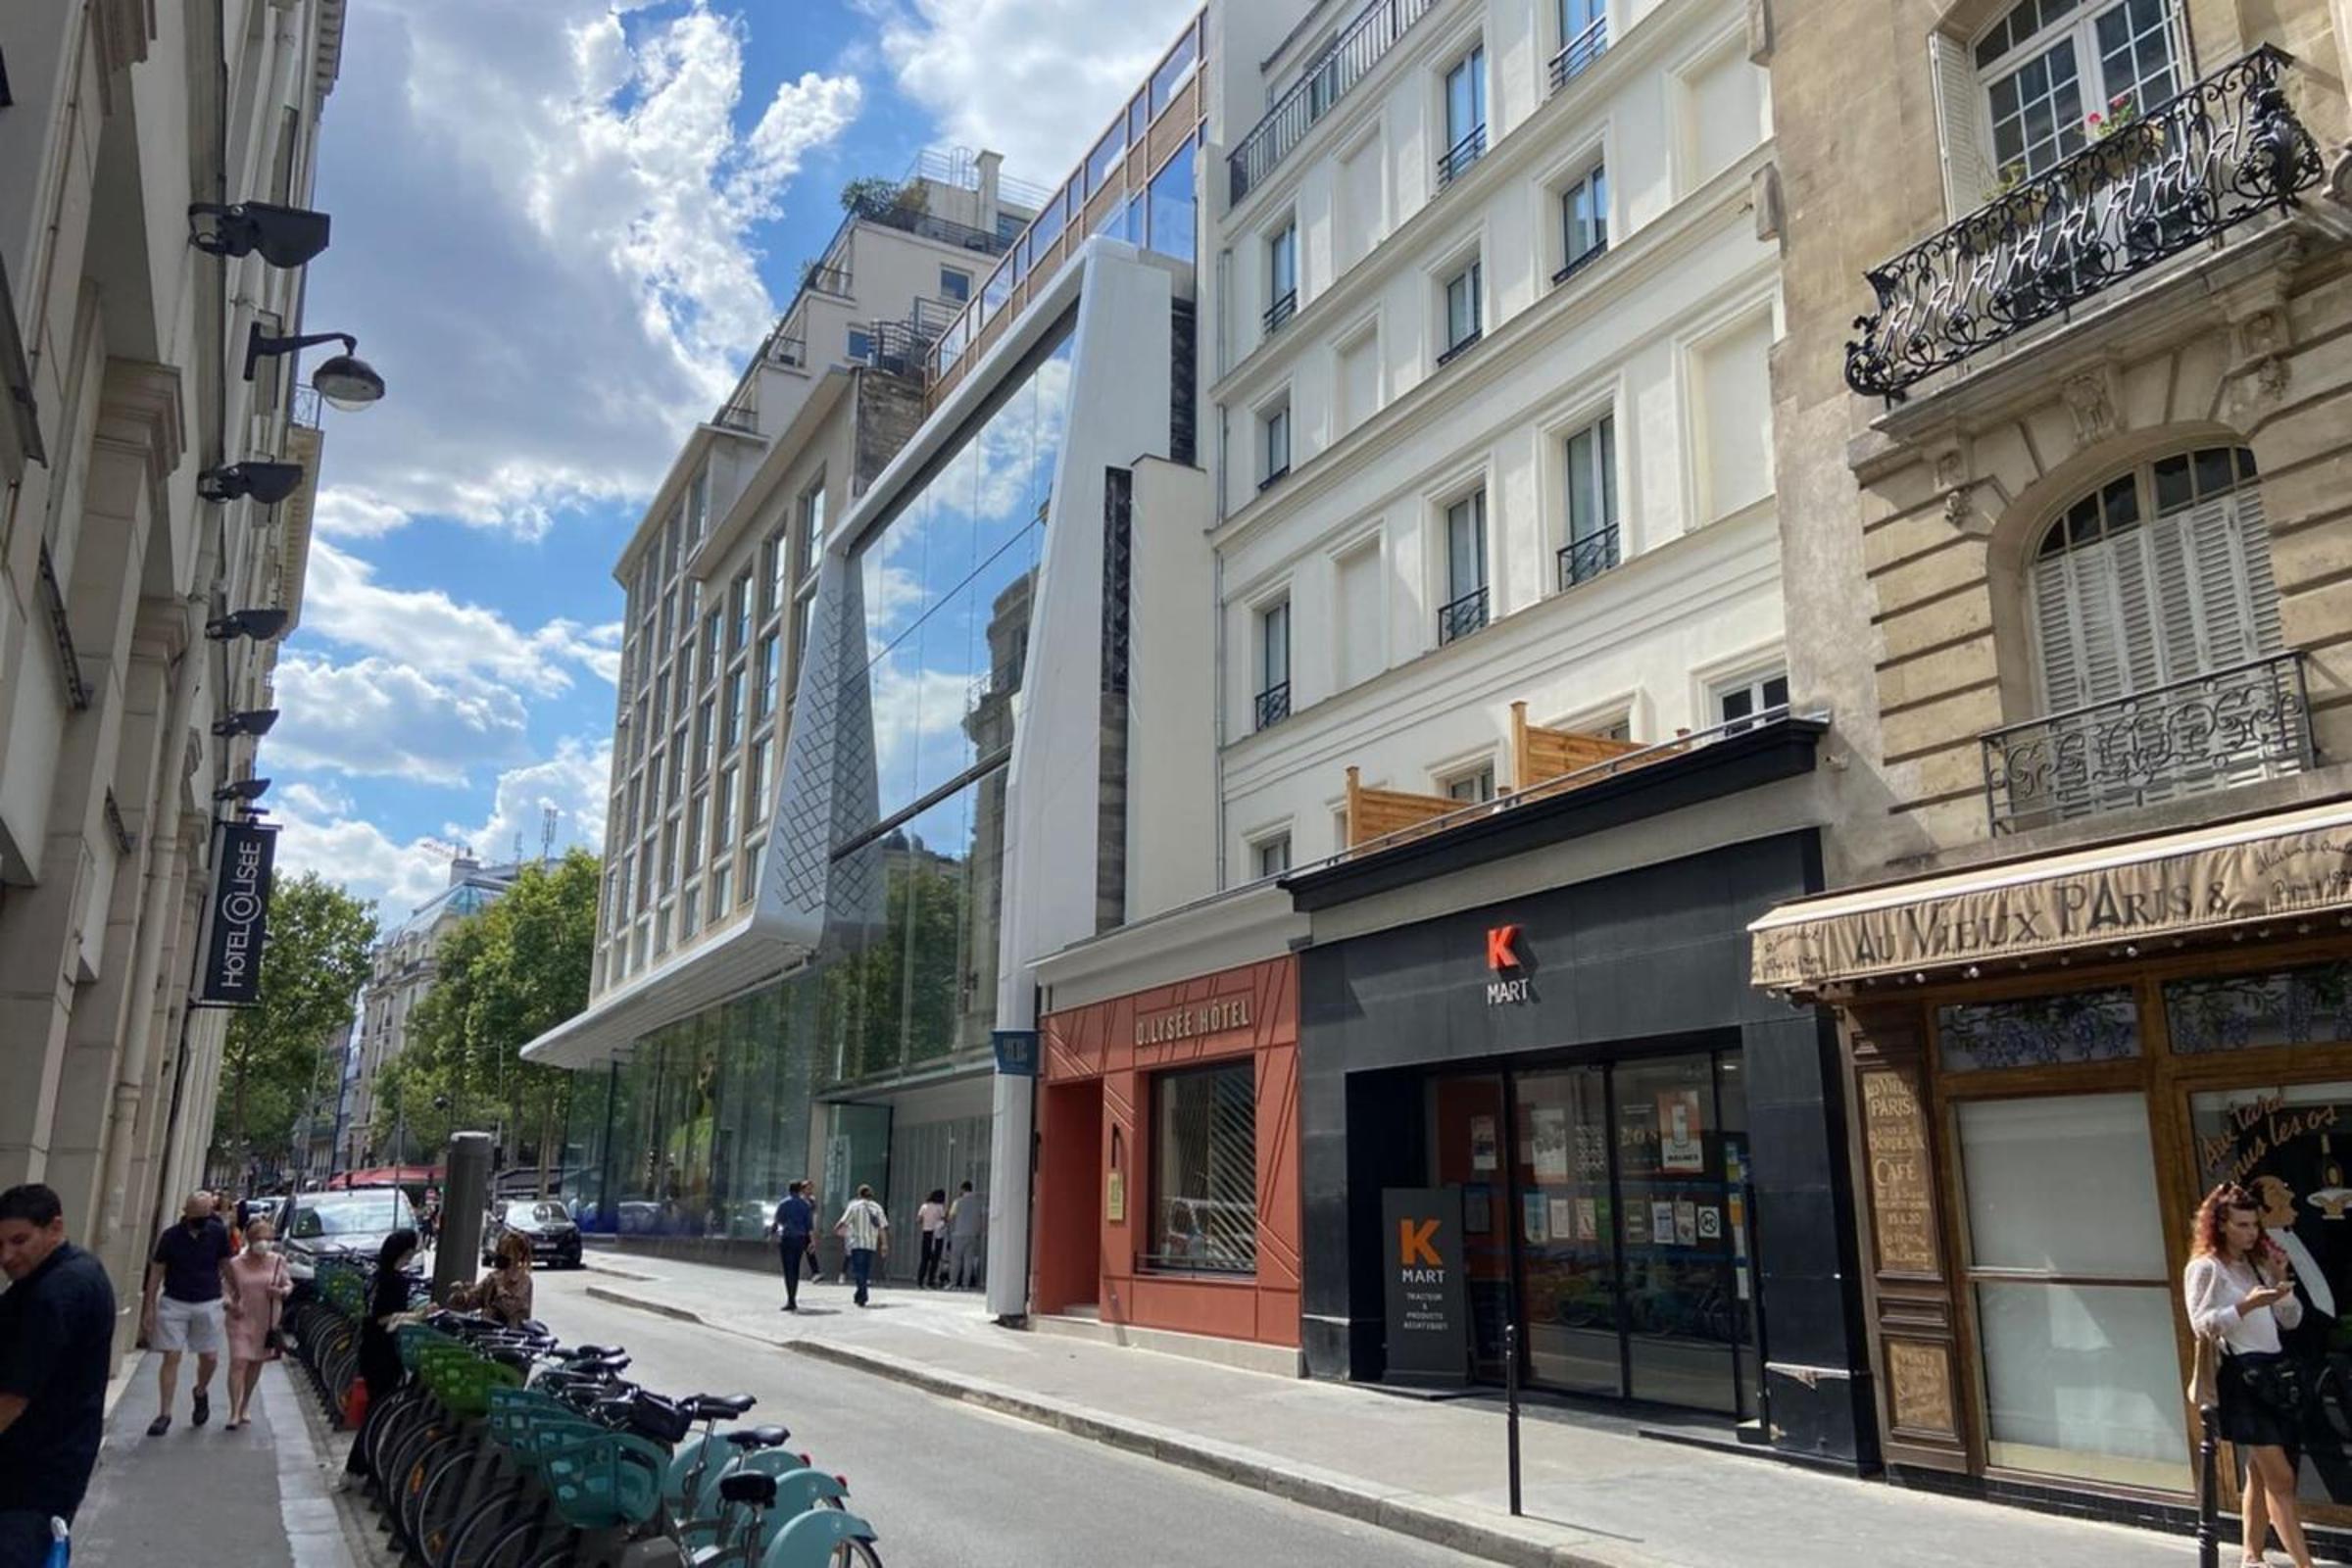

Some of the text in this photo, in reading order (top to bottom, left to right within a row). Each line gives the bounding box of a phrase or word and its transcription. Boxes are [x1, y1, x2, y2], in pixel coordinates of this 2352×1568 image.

[1856, 913, 1896, 962] AU
[1905, 902, 2042, 957] VIEUX
[2053, 876, 2192, 937] PARIS
[1487, 924, 1523, 970] K
[1487, 978, 1529, 1005] MART
[1199, 998, 1250, 1033] HÔTEL
[1874, 1158, 1918, 1187] CAFÉ
[1399, 1218, 1444, 1266] K
[1401, 1269, 1446, 1285] MART
